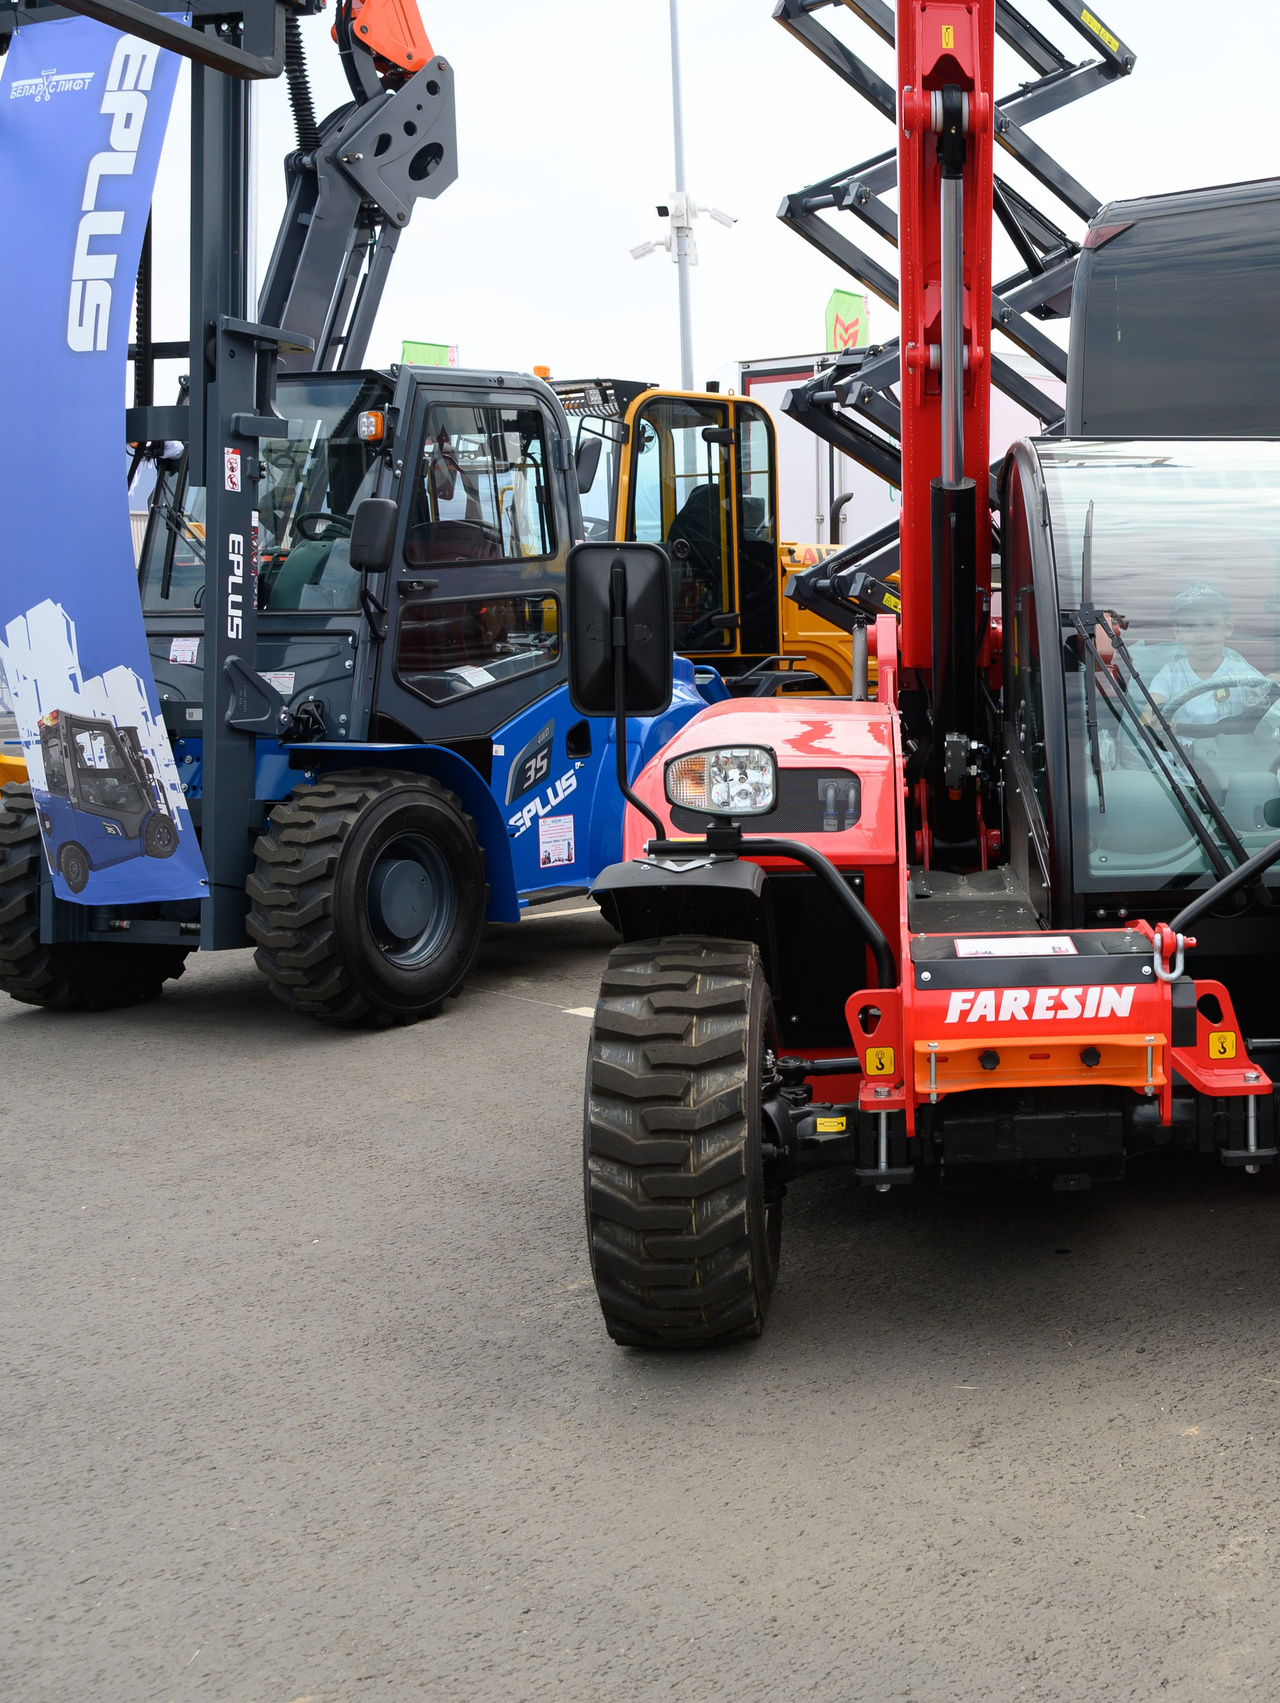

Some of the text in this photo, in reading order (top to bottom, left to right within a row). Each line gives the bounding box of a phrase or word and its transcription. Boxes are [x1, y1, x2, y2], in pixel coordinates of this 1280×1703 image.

[67, 34, 160, 352] EPLUS
[227, 533, 244, 640] EPLUS
[508, 768, 578, 838] EPLUS
[523, 747, 549, 789] 35
[944, 986, 1137, 1023] FARESIN
